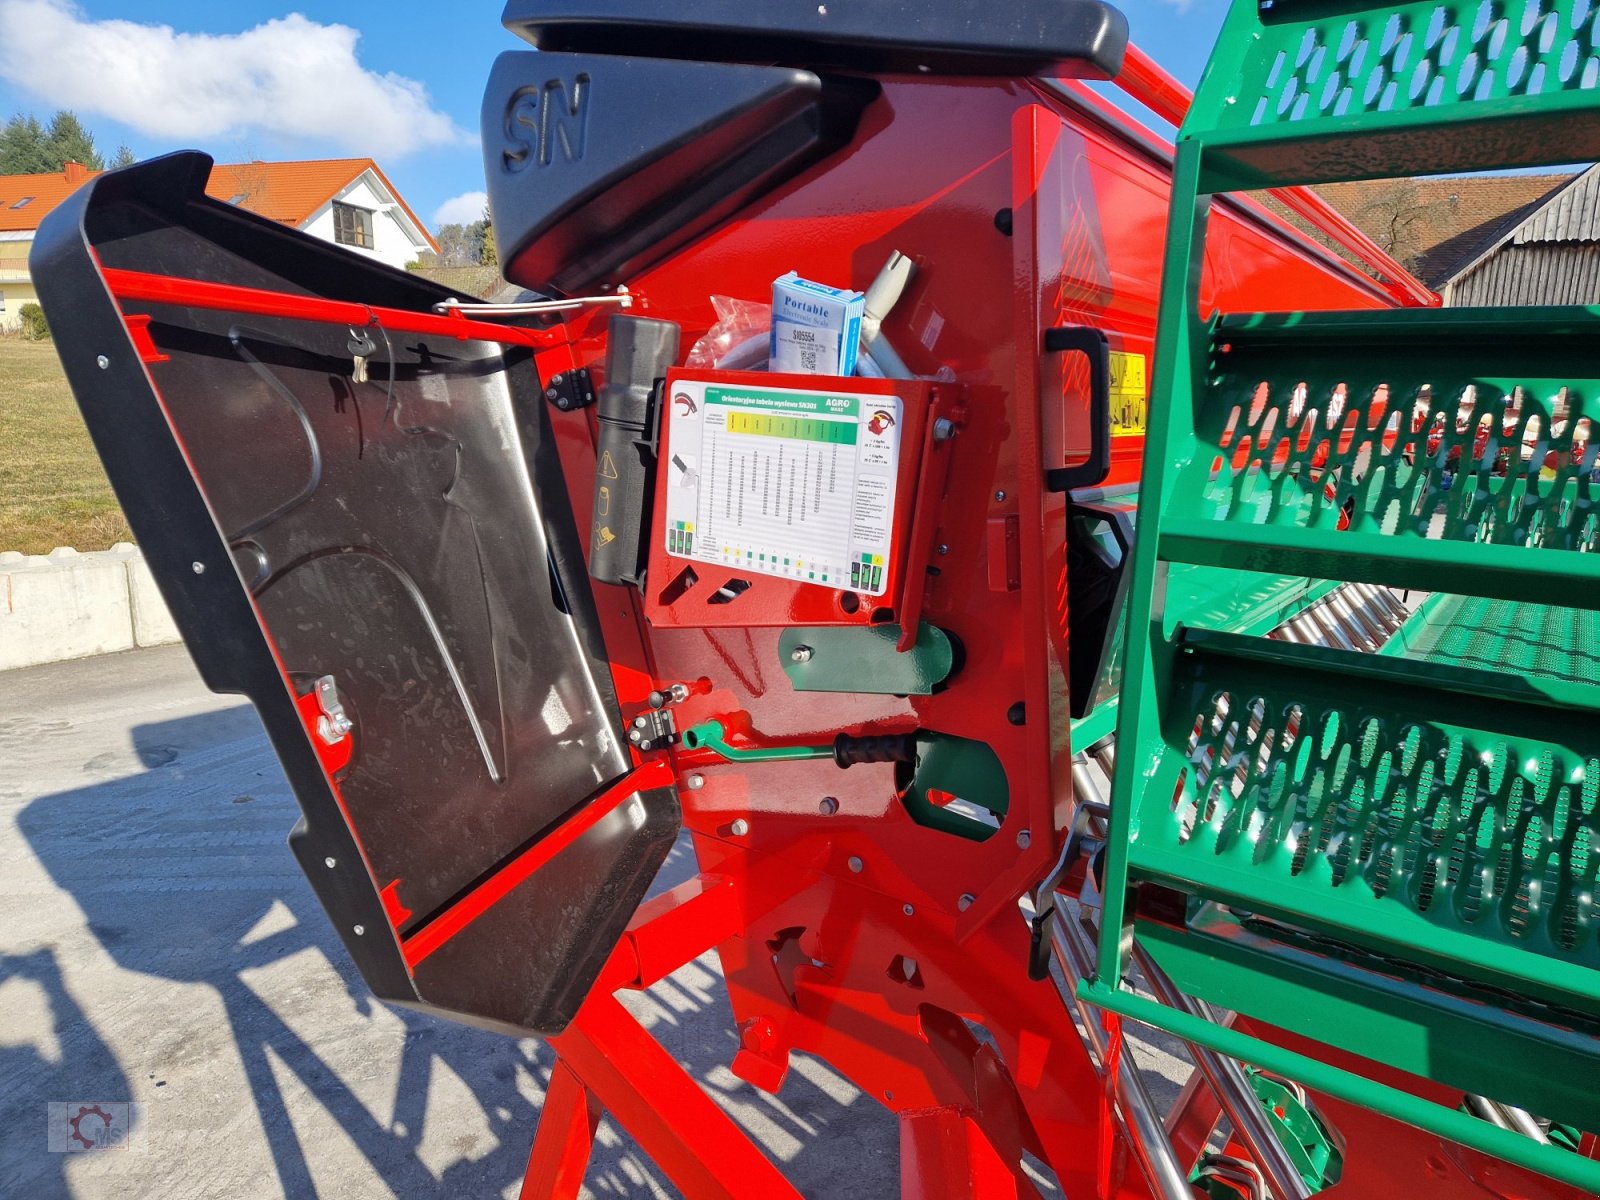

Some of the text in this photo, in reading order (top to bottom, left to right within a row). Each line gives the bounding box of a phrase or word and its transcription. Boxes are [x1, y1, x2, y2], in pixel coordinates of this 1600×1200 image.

[503, 72, 590, 173] SN
[784, 295, 829, 318] Portable
[792, 329, 815, 343] SI05554
[756, 398, 774, 406] tabela
[825, 398, 850, 408] AGRO
